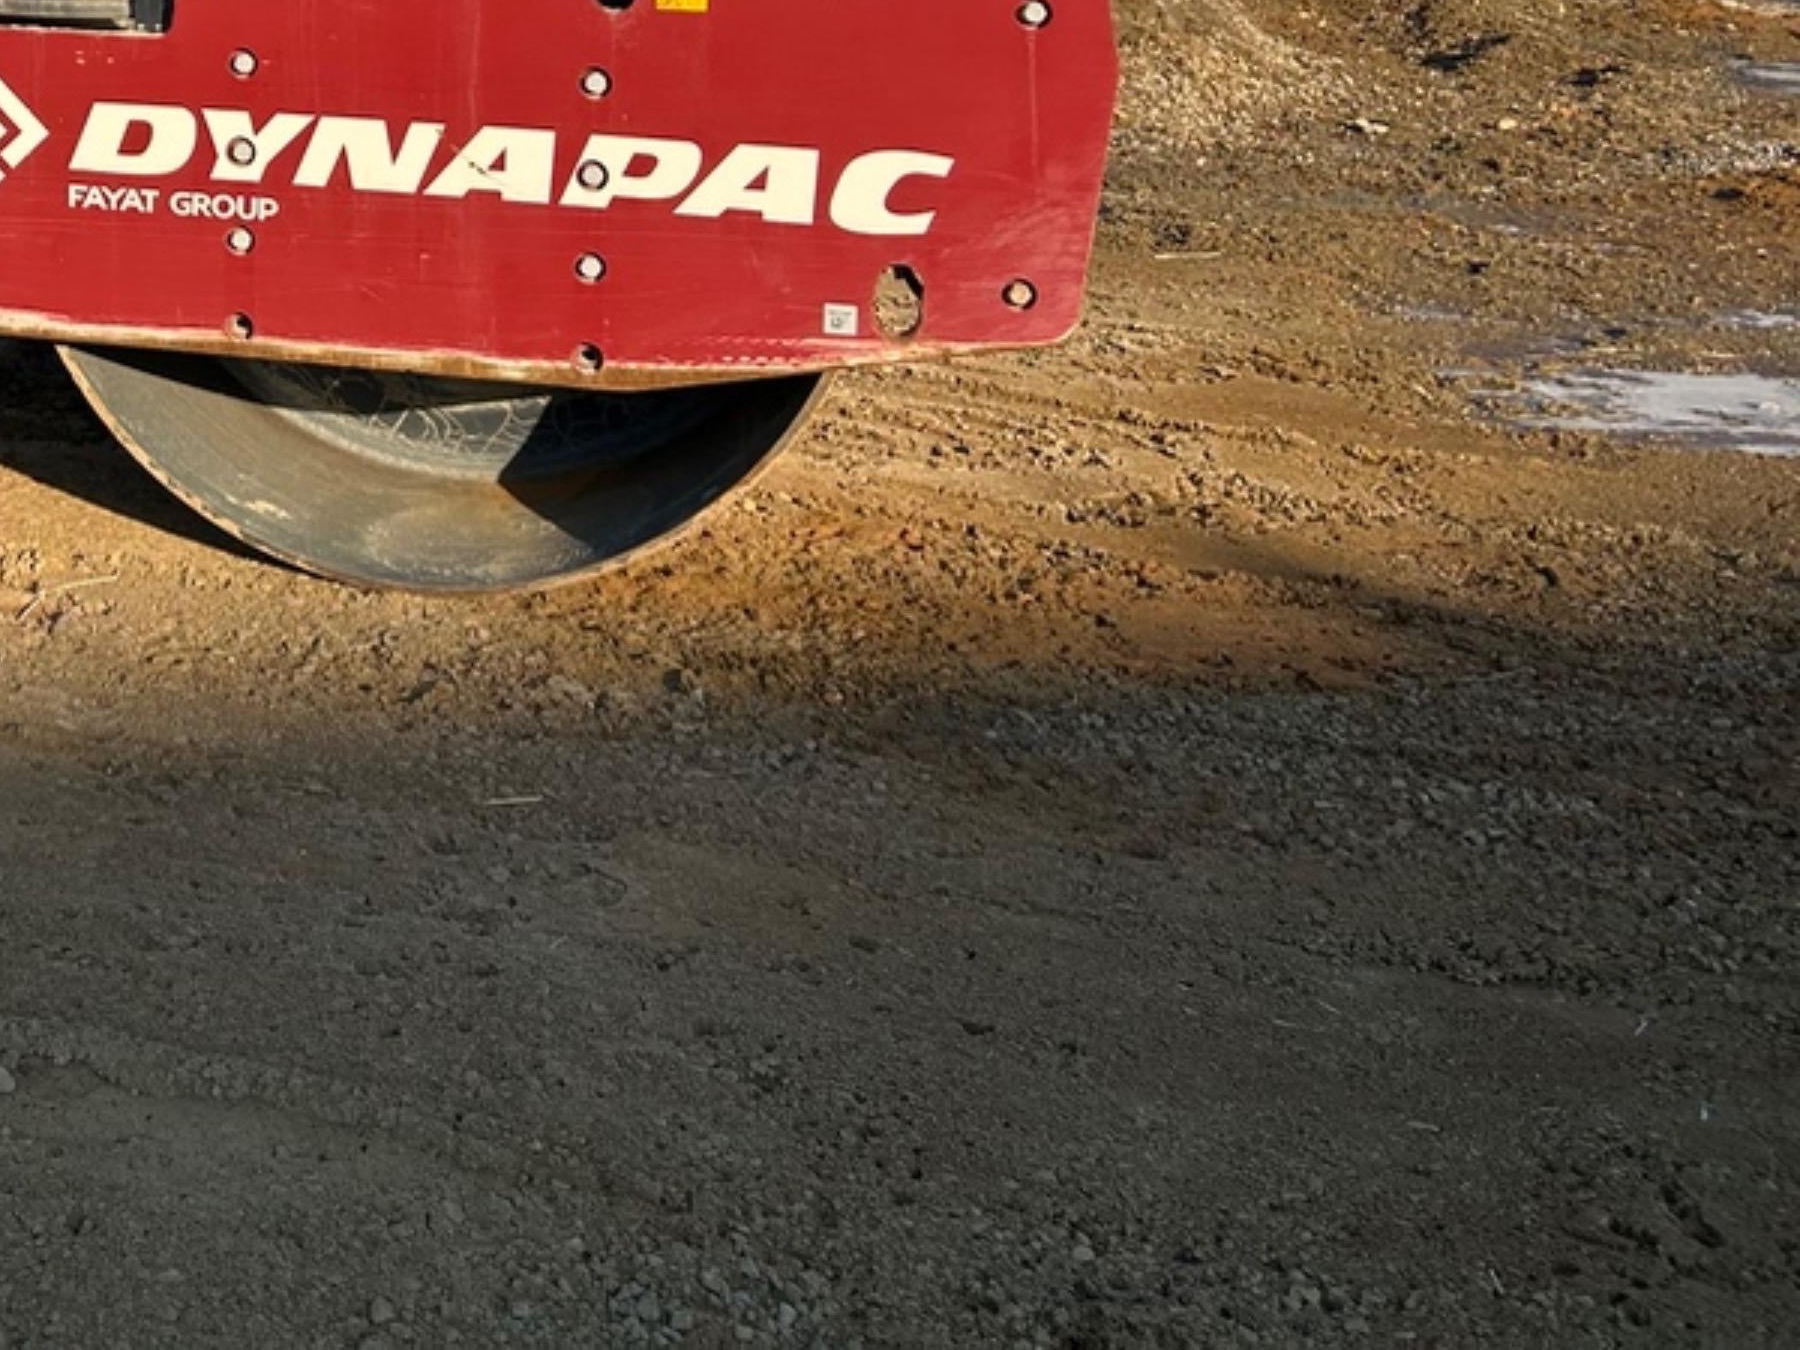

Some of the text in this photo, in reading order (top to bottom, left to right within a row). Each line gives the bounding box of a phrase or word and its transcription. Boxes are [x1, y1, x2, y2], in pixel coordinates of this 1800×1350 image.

[67, 184, 279, 221] FAYAT GROUP
[69, 103, 954, 235] DYNAPAC
